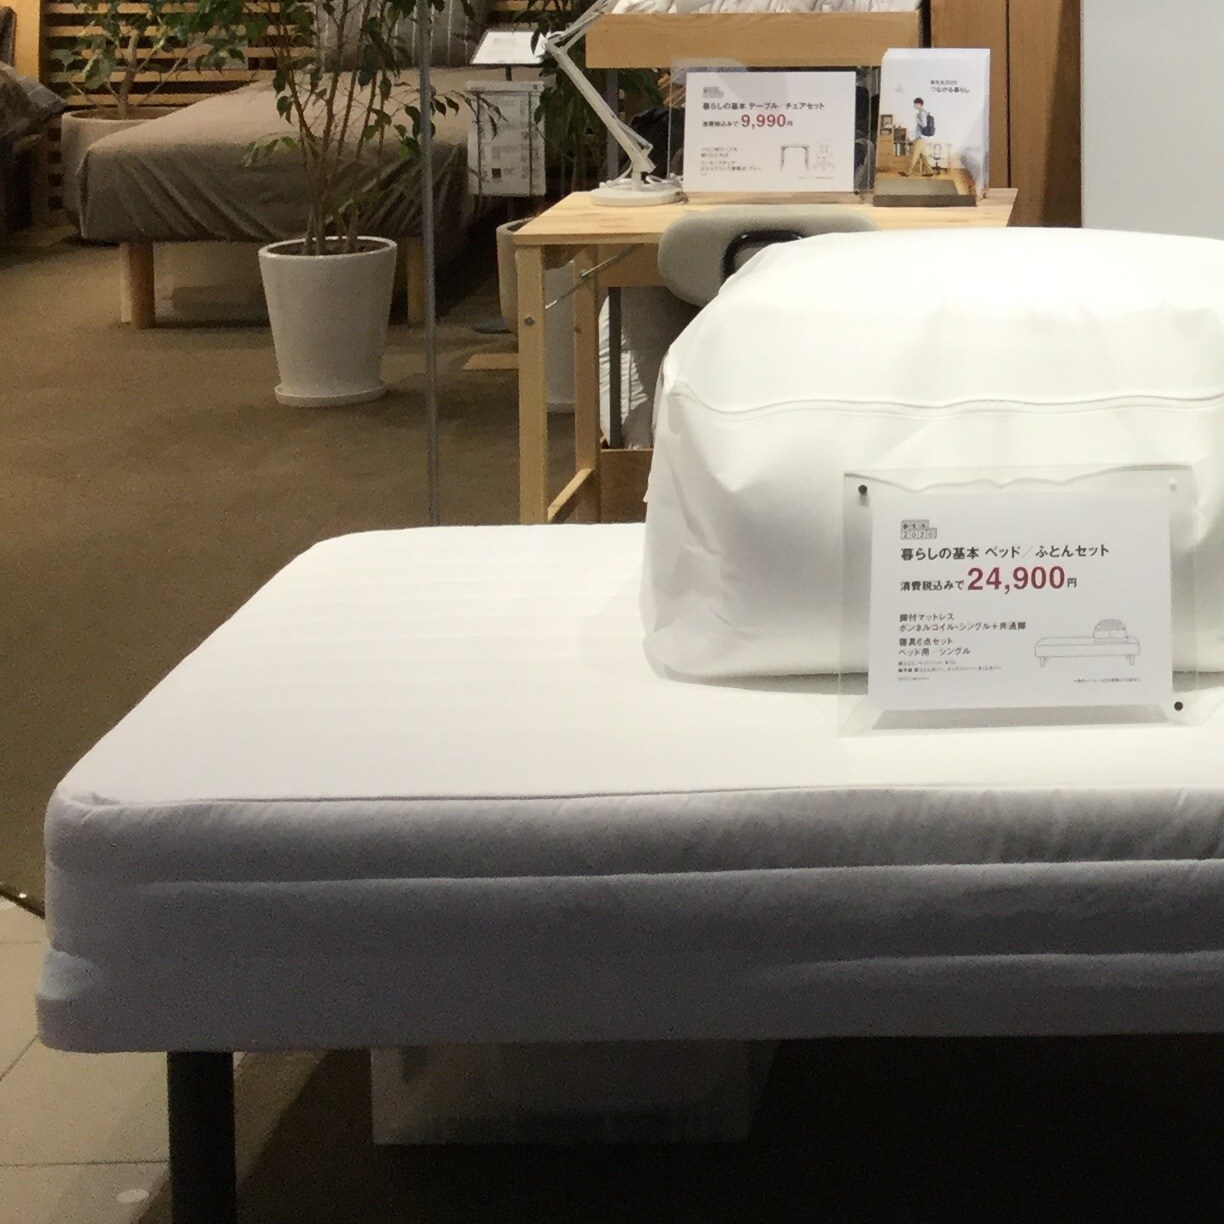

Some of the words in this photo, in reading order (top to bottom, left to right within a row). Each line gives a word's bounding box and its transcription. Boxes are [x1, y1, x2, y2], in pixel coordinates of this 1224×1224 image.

[901, 546, 980, 561] 暮らしの基本
